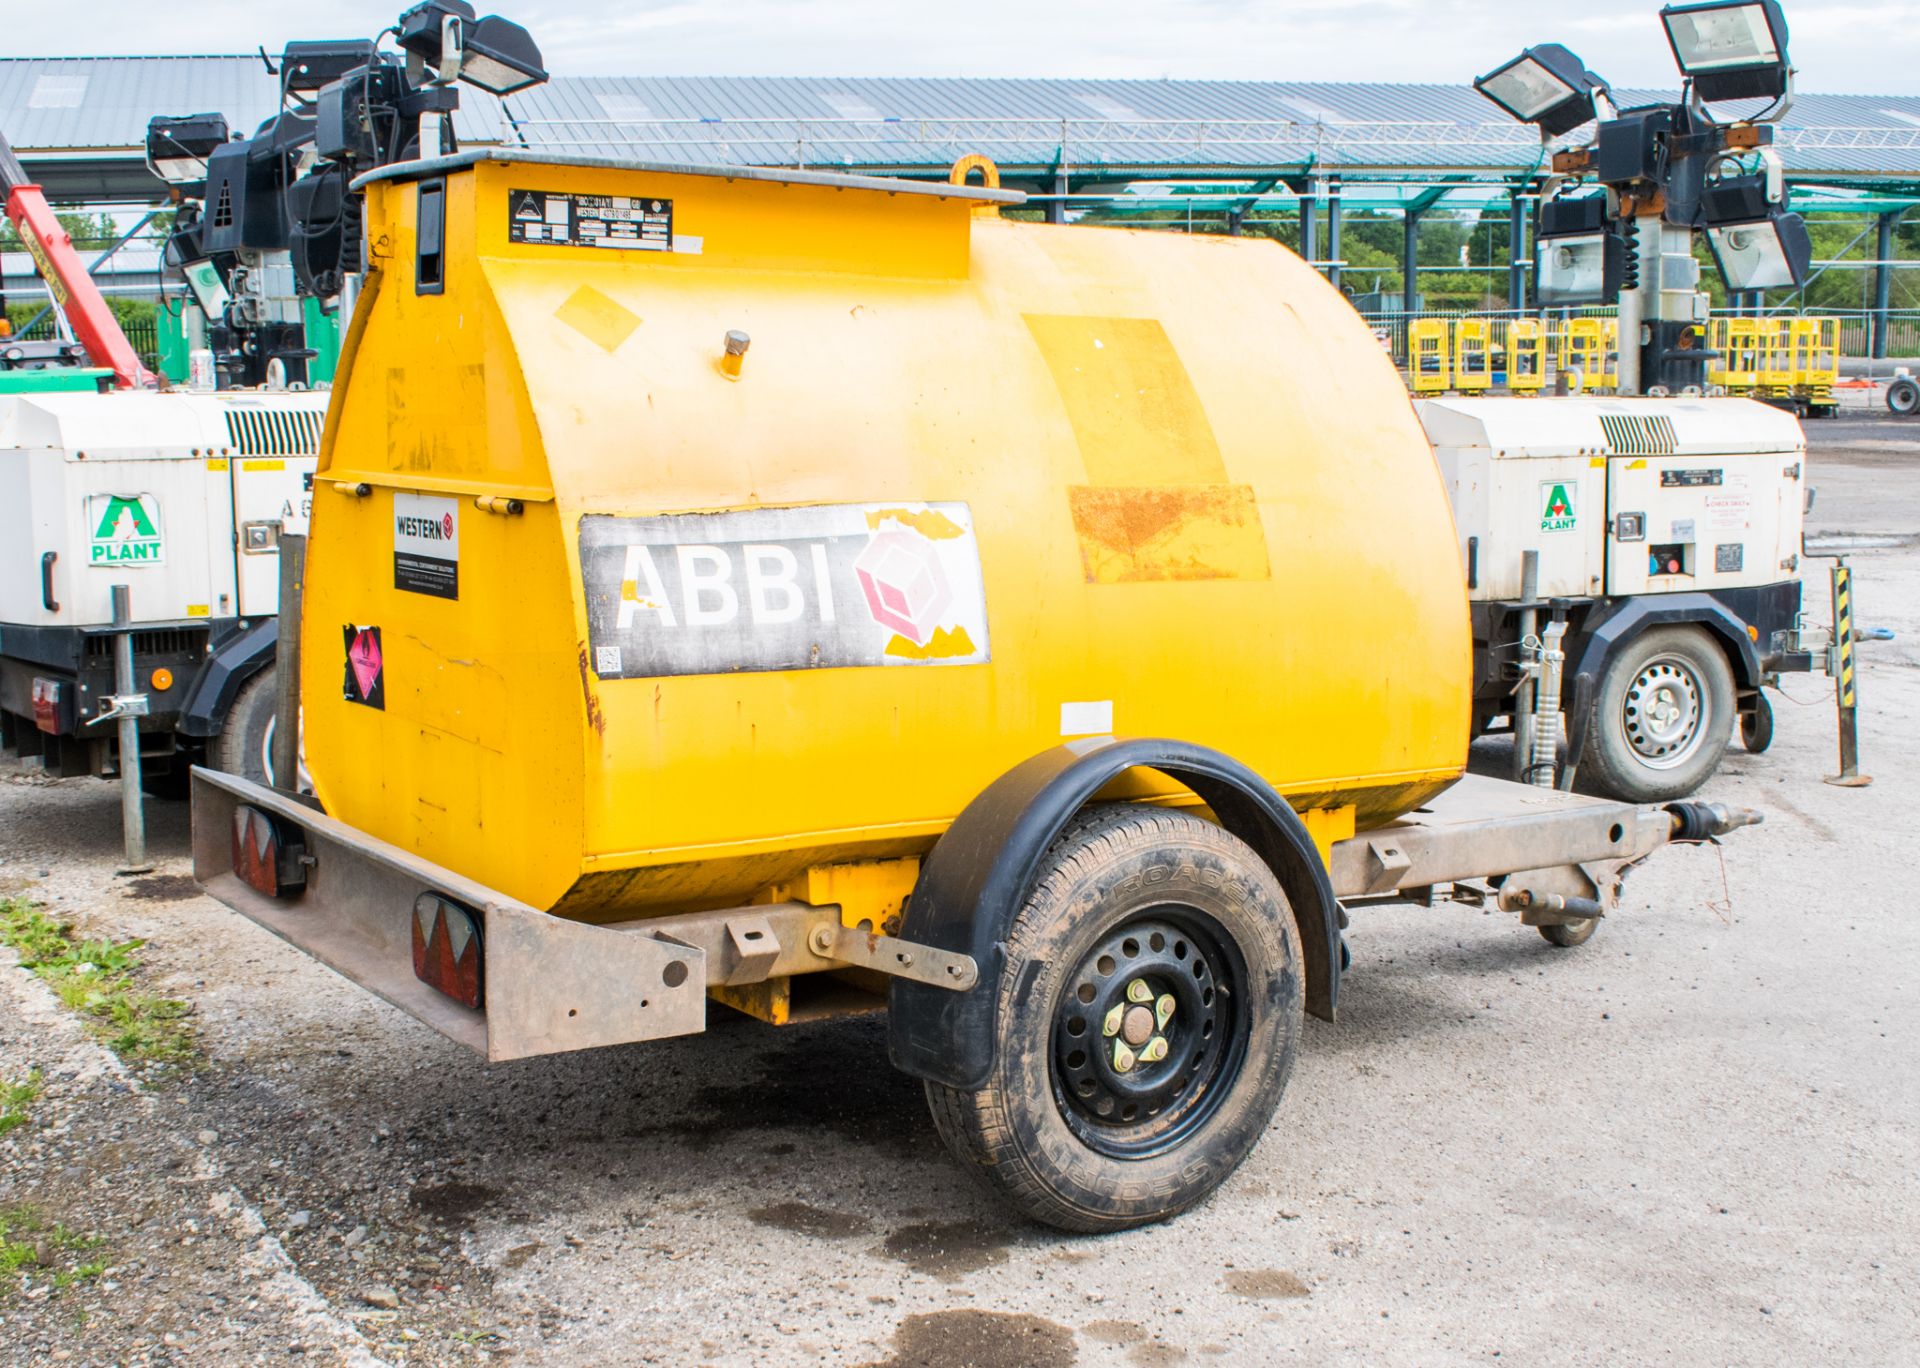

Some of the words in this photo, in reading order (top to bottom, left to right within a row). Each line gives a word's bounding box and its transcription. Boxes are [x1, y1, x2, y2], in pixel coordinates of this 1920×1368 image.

[1544, 485, 1573, 517] A
[95, 495, 157, 538] A
[397, 515, 442, 540] WESTERN
[1541, 518, 1576, 530] PLANT
[92, 542, 161, 561] PLANT
[616, 543, 836, 629] ABBI
